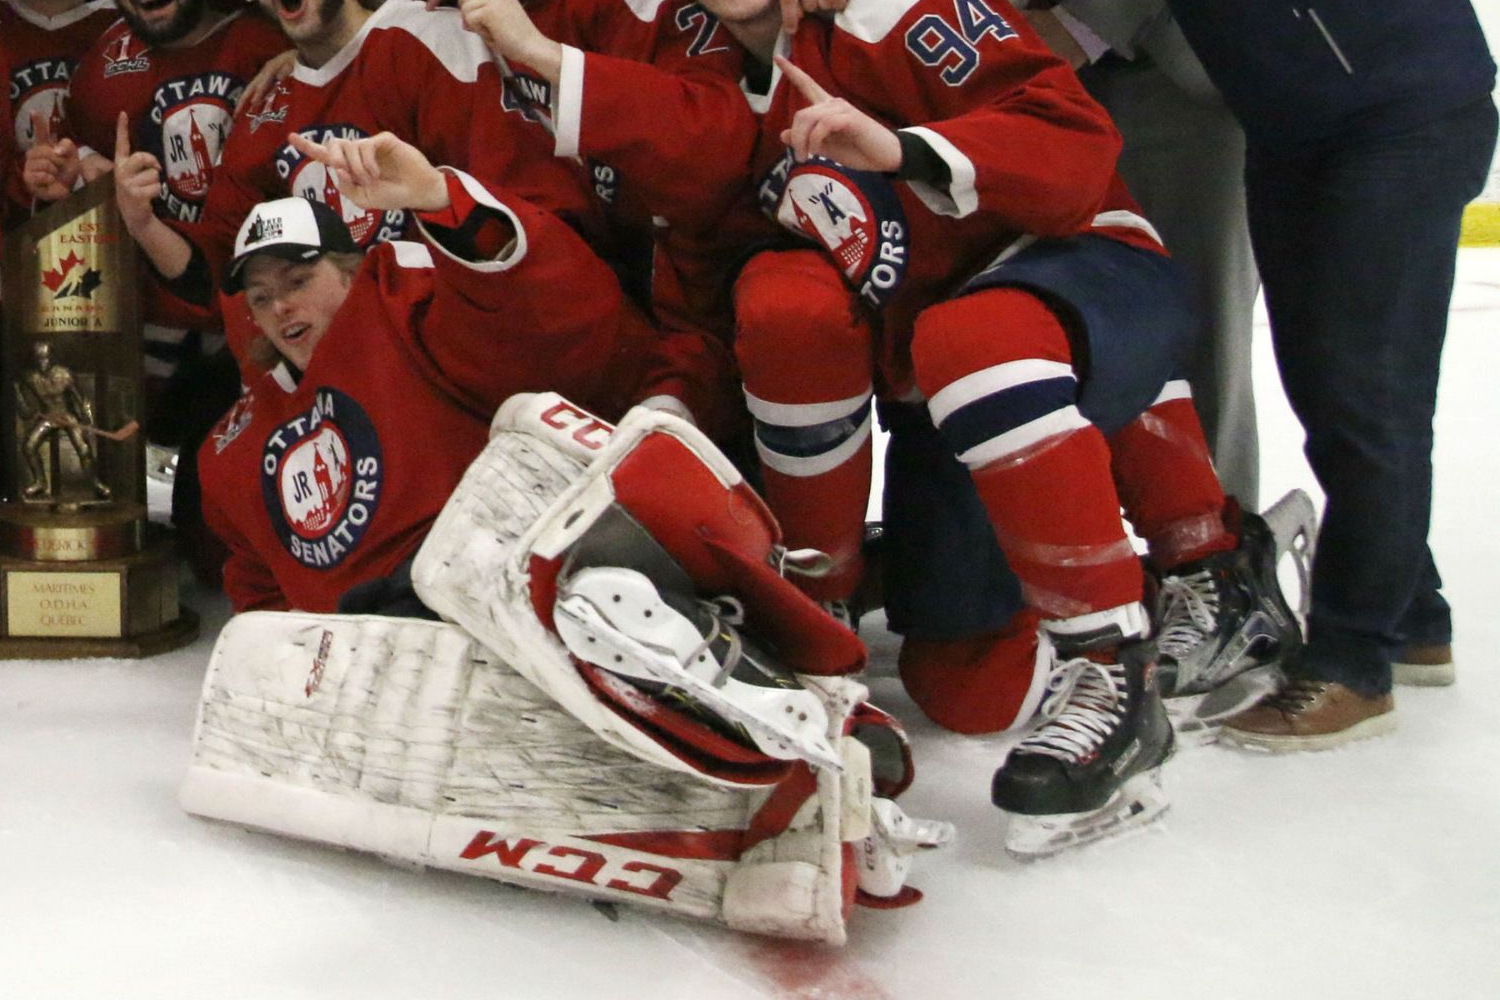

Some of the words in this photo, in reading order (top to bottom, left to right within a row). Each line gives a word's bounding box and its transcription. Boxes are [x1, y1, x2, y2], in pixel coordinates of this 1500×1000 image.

[170, 134, 188, 163] JR
[290, 456, 378, 567] SENATORS
[292, 471, 313, 504] JR
[459, 829, 684, 903] CCM
